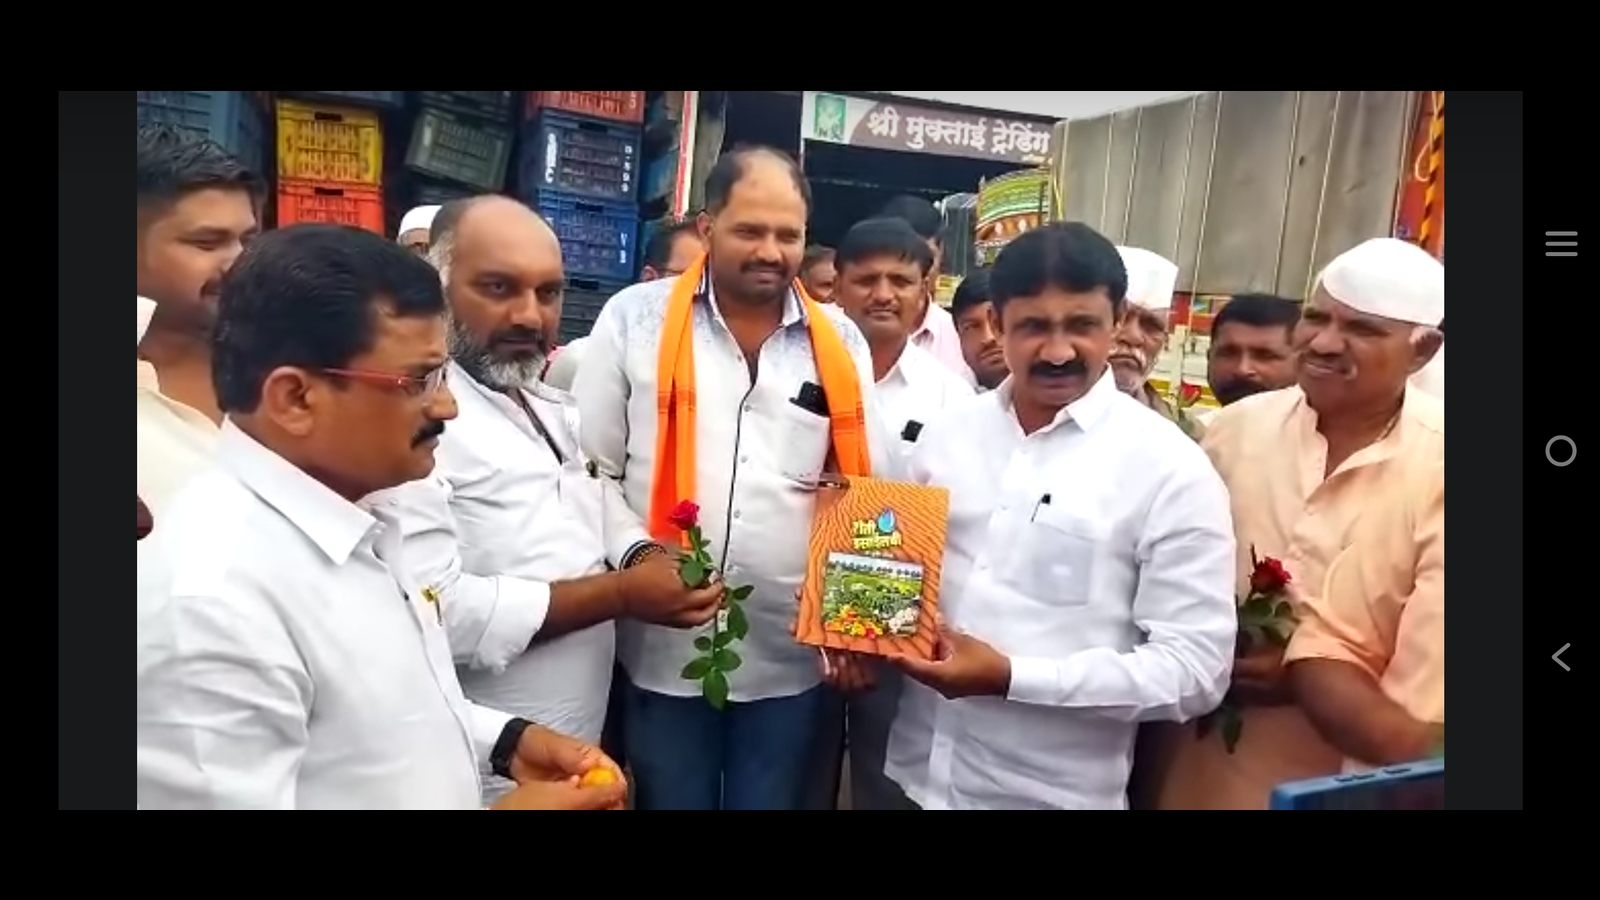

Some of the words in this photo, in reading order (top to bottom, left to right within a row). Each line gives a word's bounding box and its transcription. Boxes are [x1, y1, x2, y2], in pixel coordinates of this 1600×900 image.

[867, 105, 900, 138] श्री
[906, 115, 987, 151] मुक्ताई
[991, 120, 1051, 154] ट्रेडिंग
